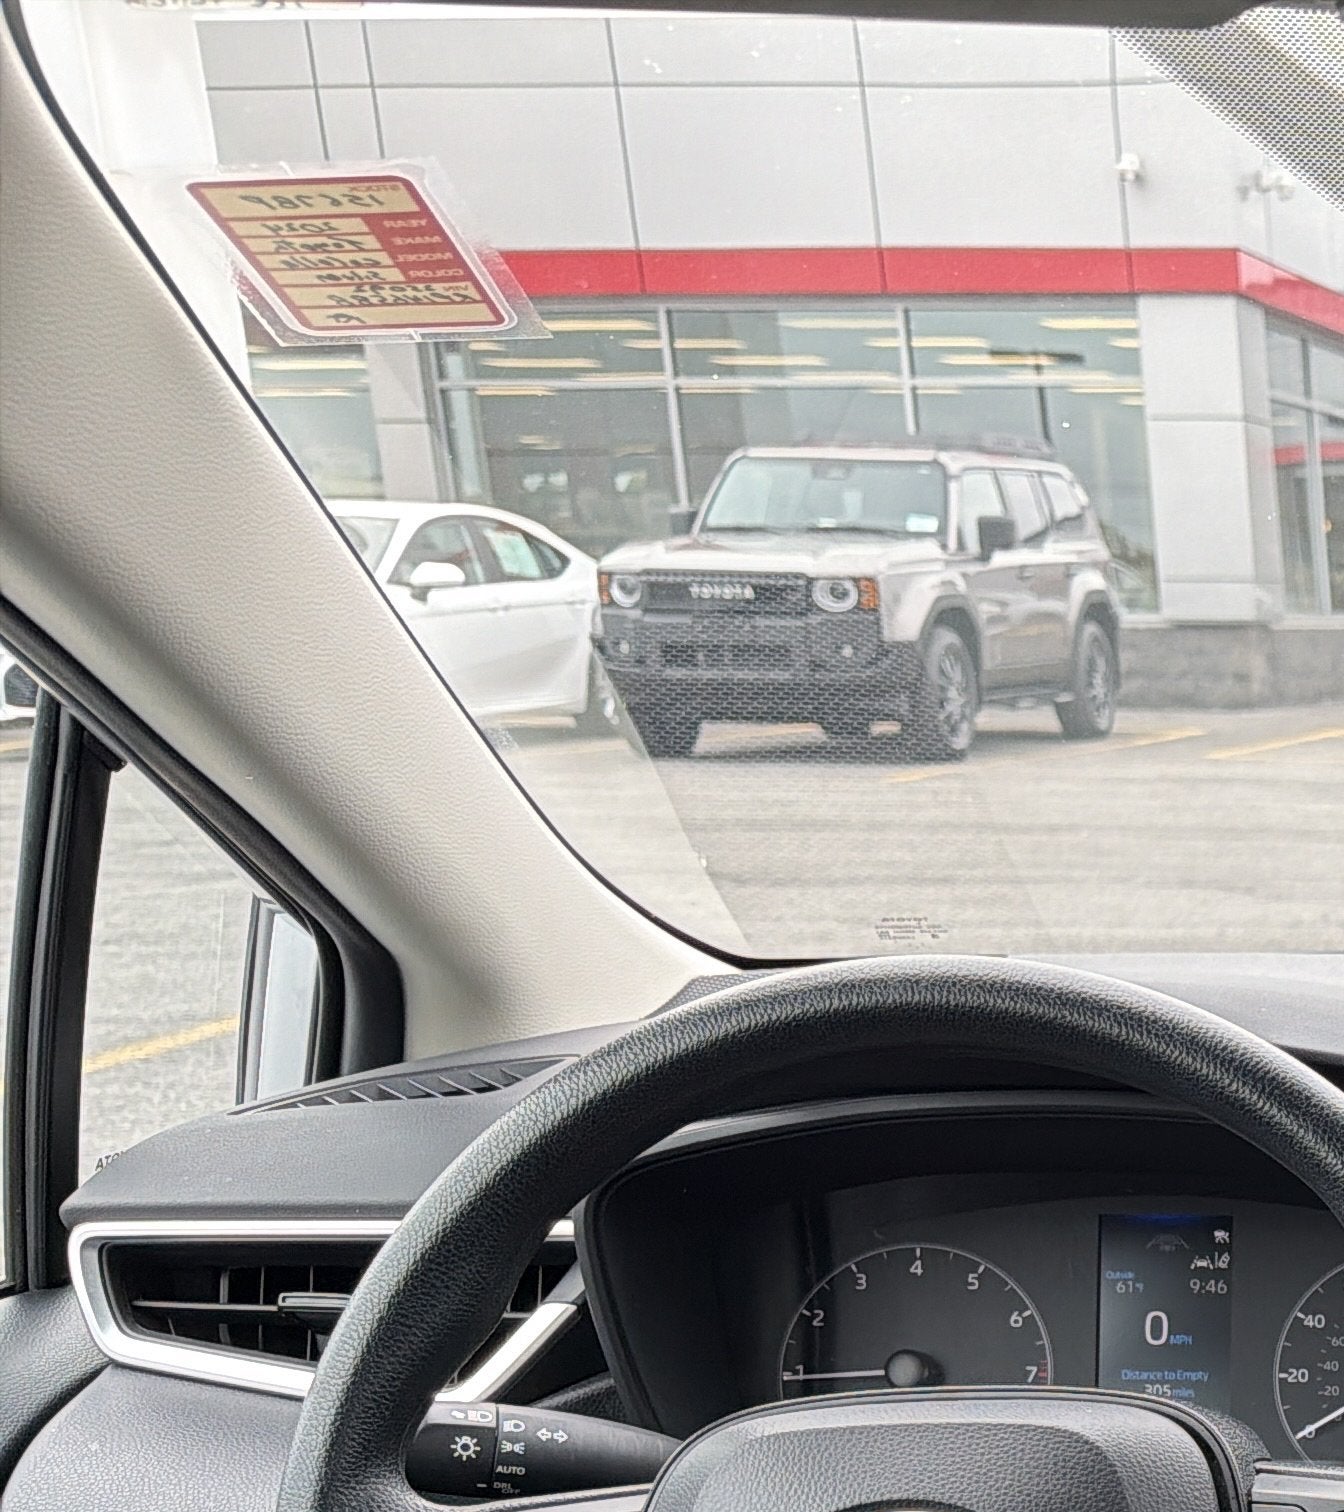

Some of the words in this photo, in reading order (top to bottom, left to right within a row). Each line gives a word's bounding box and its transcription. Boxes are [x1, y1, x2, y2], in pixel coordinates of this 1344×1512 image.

[909, 1259, 924, 1276] 4
[854, 1273, 867, 1290] 3
[966, 1273, 979, 1290] 5
[1189, 1279, 1228, 1295] 9:46
[812, 1309, 824, 1327] 2
[1010, 1310, 1023, 1327] 6
[1303, 1314, 1326, 1329] 40
[1144, 1310, 1169, 1346] 0
[1024, 1365, 1038, 1383] 7
[1323, 1360, 1339, 1372] 40
[1121, 1368, 1163, 1380] Distance
[1164, 1369, 1176, 1380] to
[1177, 1369, 1209, 1383] Empty
[1286, 1368, 1309, 1383] 20
[1324, 1385, 1340, 1396] 20
[495, 1465, 526, 1476] AUTO
